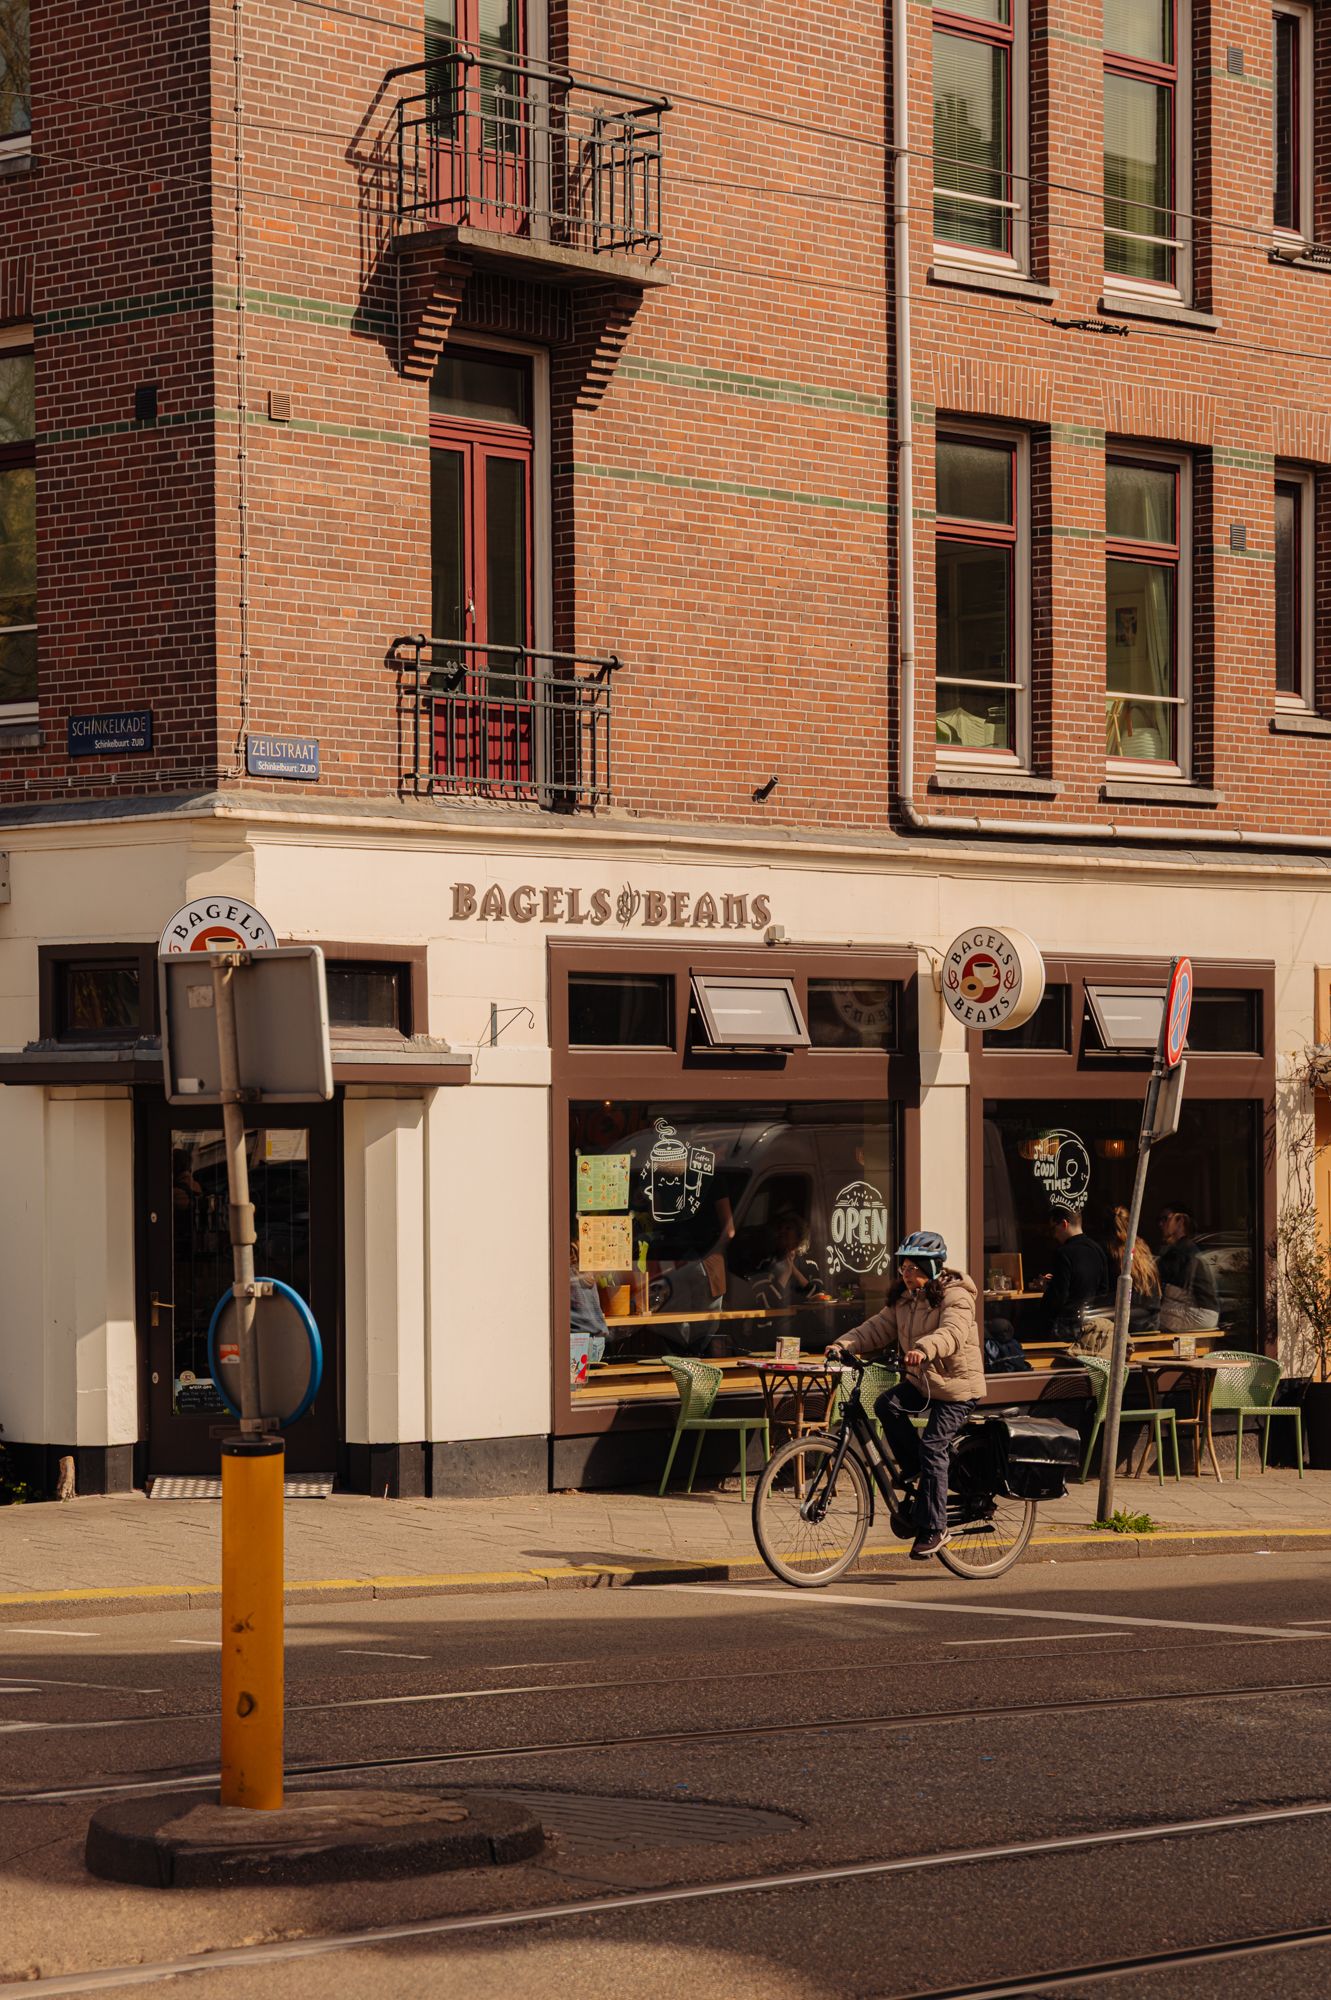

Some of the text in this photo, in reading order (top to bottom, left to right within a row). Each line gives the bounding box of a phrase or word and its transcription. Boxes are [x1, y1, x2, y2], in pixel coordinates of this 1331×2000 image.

[72, 715, 146, 736] SCHINKELKADE
[94, 738, 145, 749] Schinkelbuurt ZUID
[252, 740, 316, 760] ZEILSTRAAT
[258, 760, 316, 774] Schinkelbuurt ZUID
[449, 882, 612, 926] BAGELS
[641, 889, 772, 930] BEANS
[173, 904, 265, 941] BAGELS
[951, 934, 1013, 965] BAGELS
[953, 996, 1010, 1023] BEANS
[692, 1160, 702, 1170] TO
[1034, 1161, 1055, 1177] GOOD
[1043, 1177, 1072, 1191] TIMES
[831, 1207, 888, 1245] OPEN
